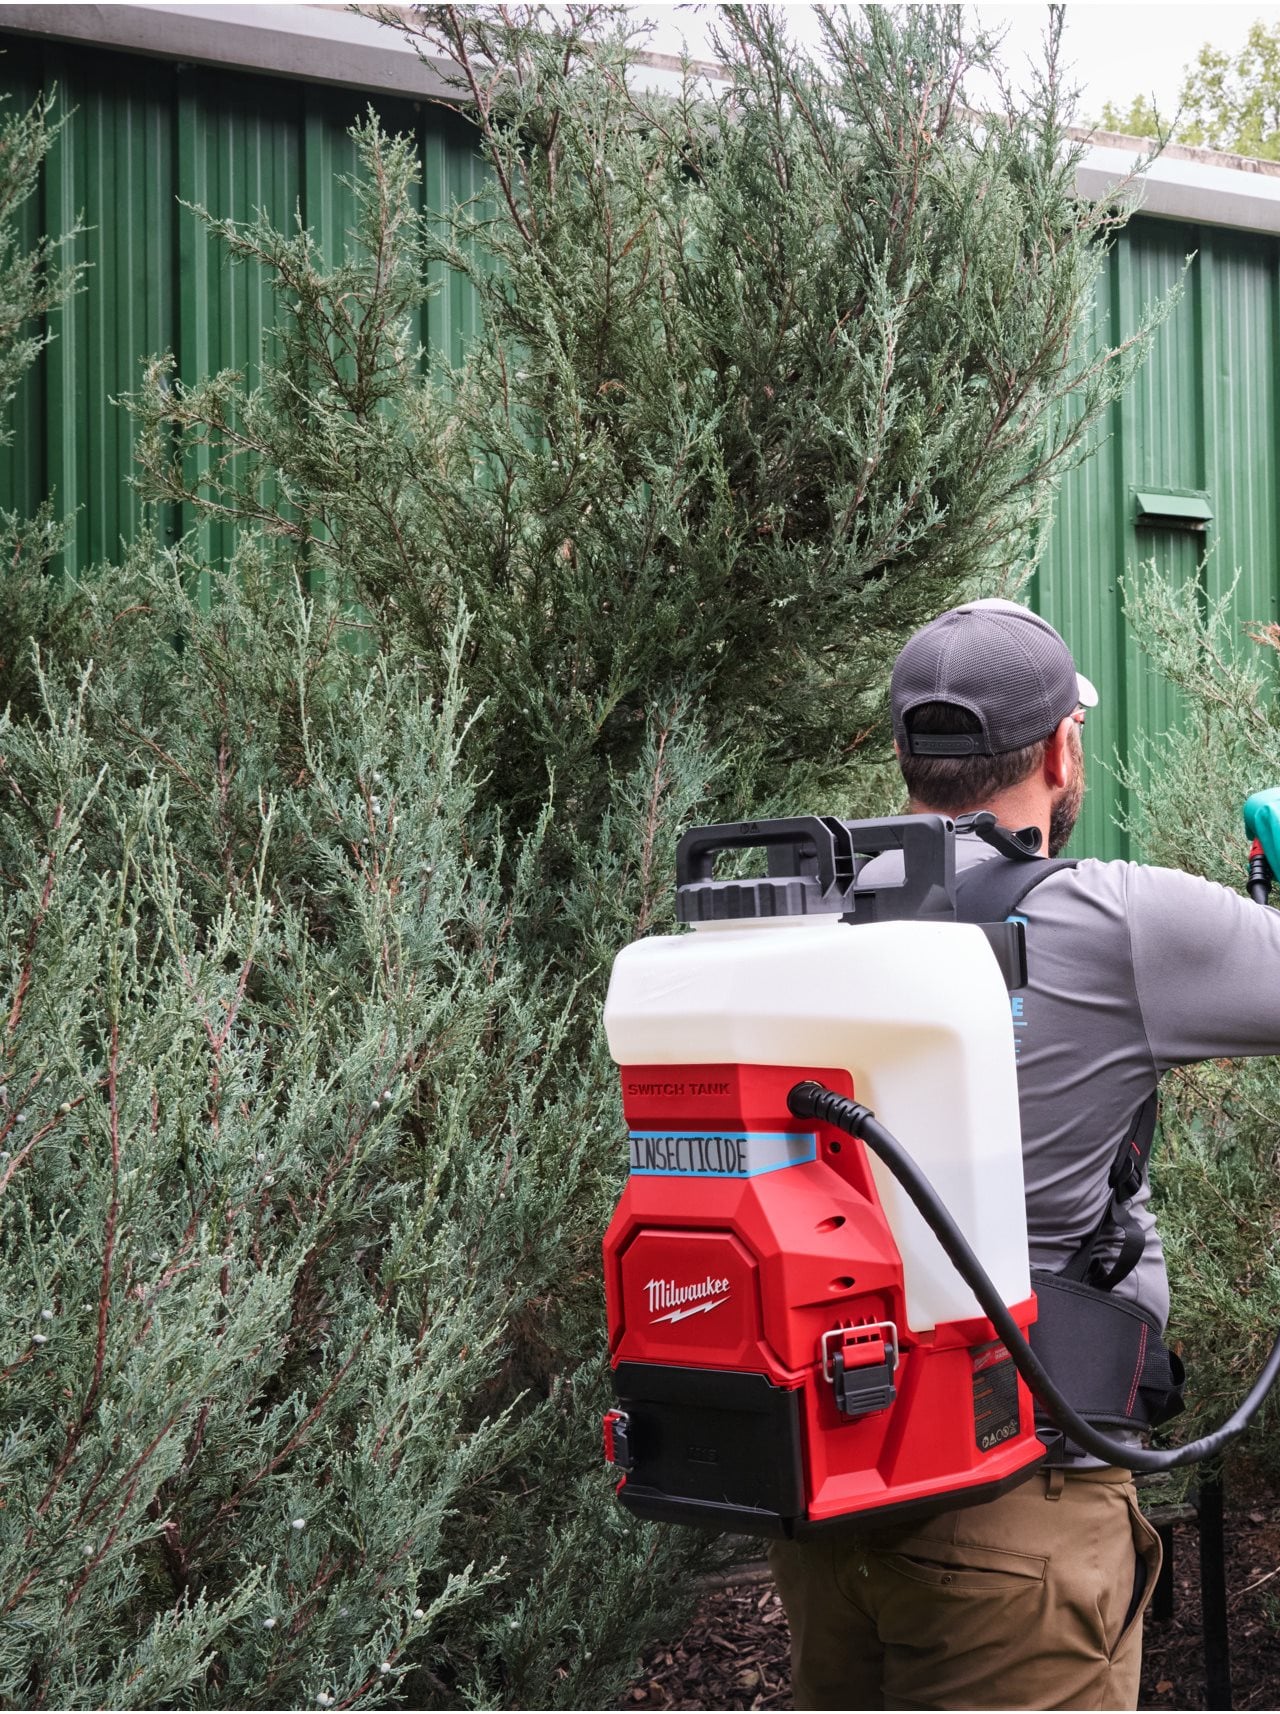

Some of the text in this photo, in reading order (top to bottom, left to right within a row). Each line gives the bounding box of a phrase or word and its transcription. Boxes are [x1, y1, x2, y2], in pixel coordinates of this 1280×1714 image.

[628, 1082, 731, 1096] SWITCH TANK
[631, 1136, 748, 1174] INSECTICIDE
[643, 1276, 731, 1313] Milwaukee
